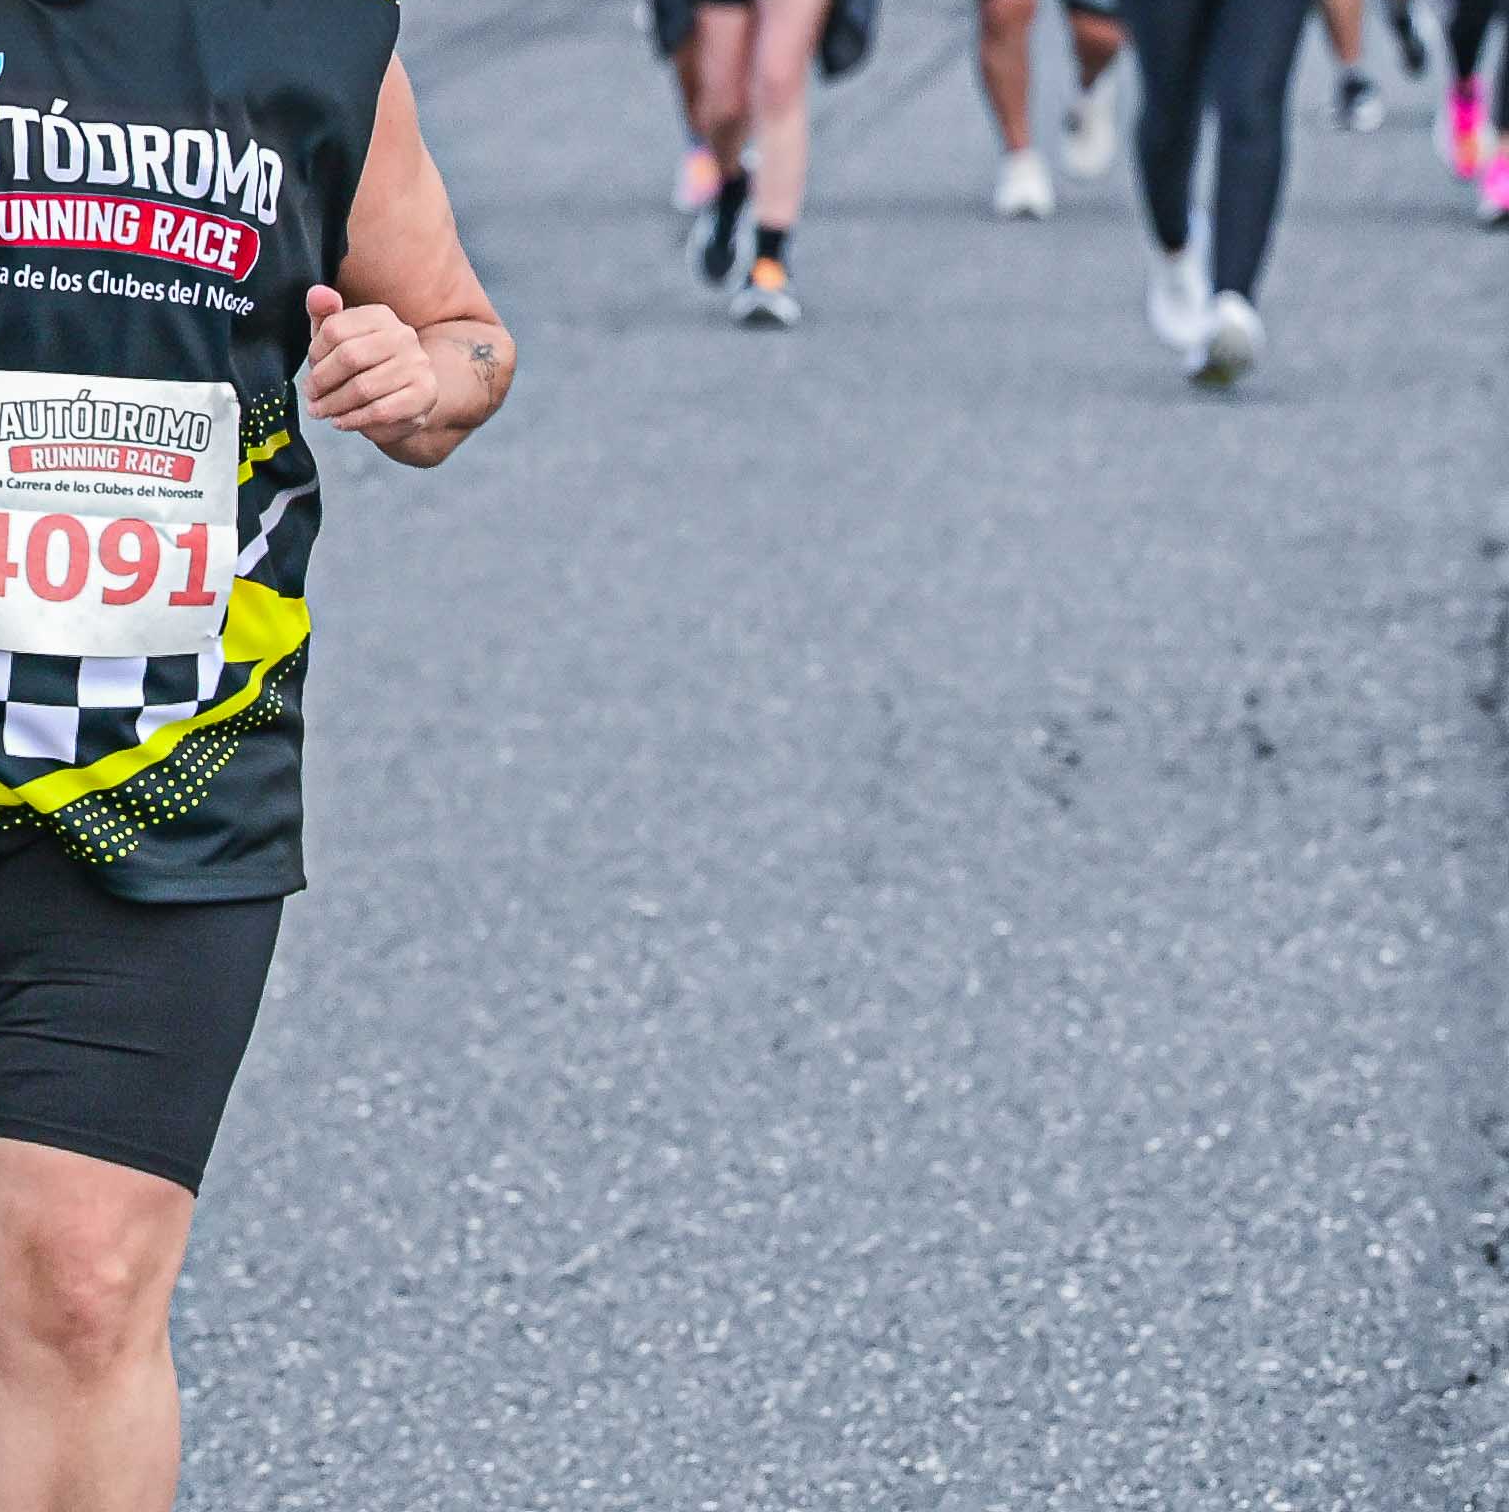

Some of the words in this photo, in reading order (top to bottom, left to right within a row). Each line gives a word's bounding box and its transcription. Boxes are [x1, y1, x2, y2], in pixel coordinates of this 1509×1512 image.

[149, 209, 241, 271] RACE
[14, 264, 45, 289] de
[50, 266, 83, 292] los
[87, 270, 165, 301] Clubes
[168, 279, 201, 305] del
[31, 447, 120, 470] RUNNING
[125, 450, 176, 478] RACE
[6, 478, 51, 491] Carrera
[55, 480, 70, 492] de
[73, 482, 90, 493] los
[94, 483, 134, 496] Clubes
[137, 484, 156, 497] del
[158, 487, 204, 499] Noroeste
